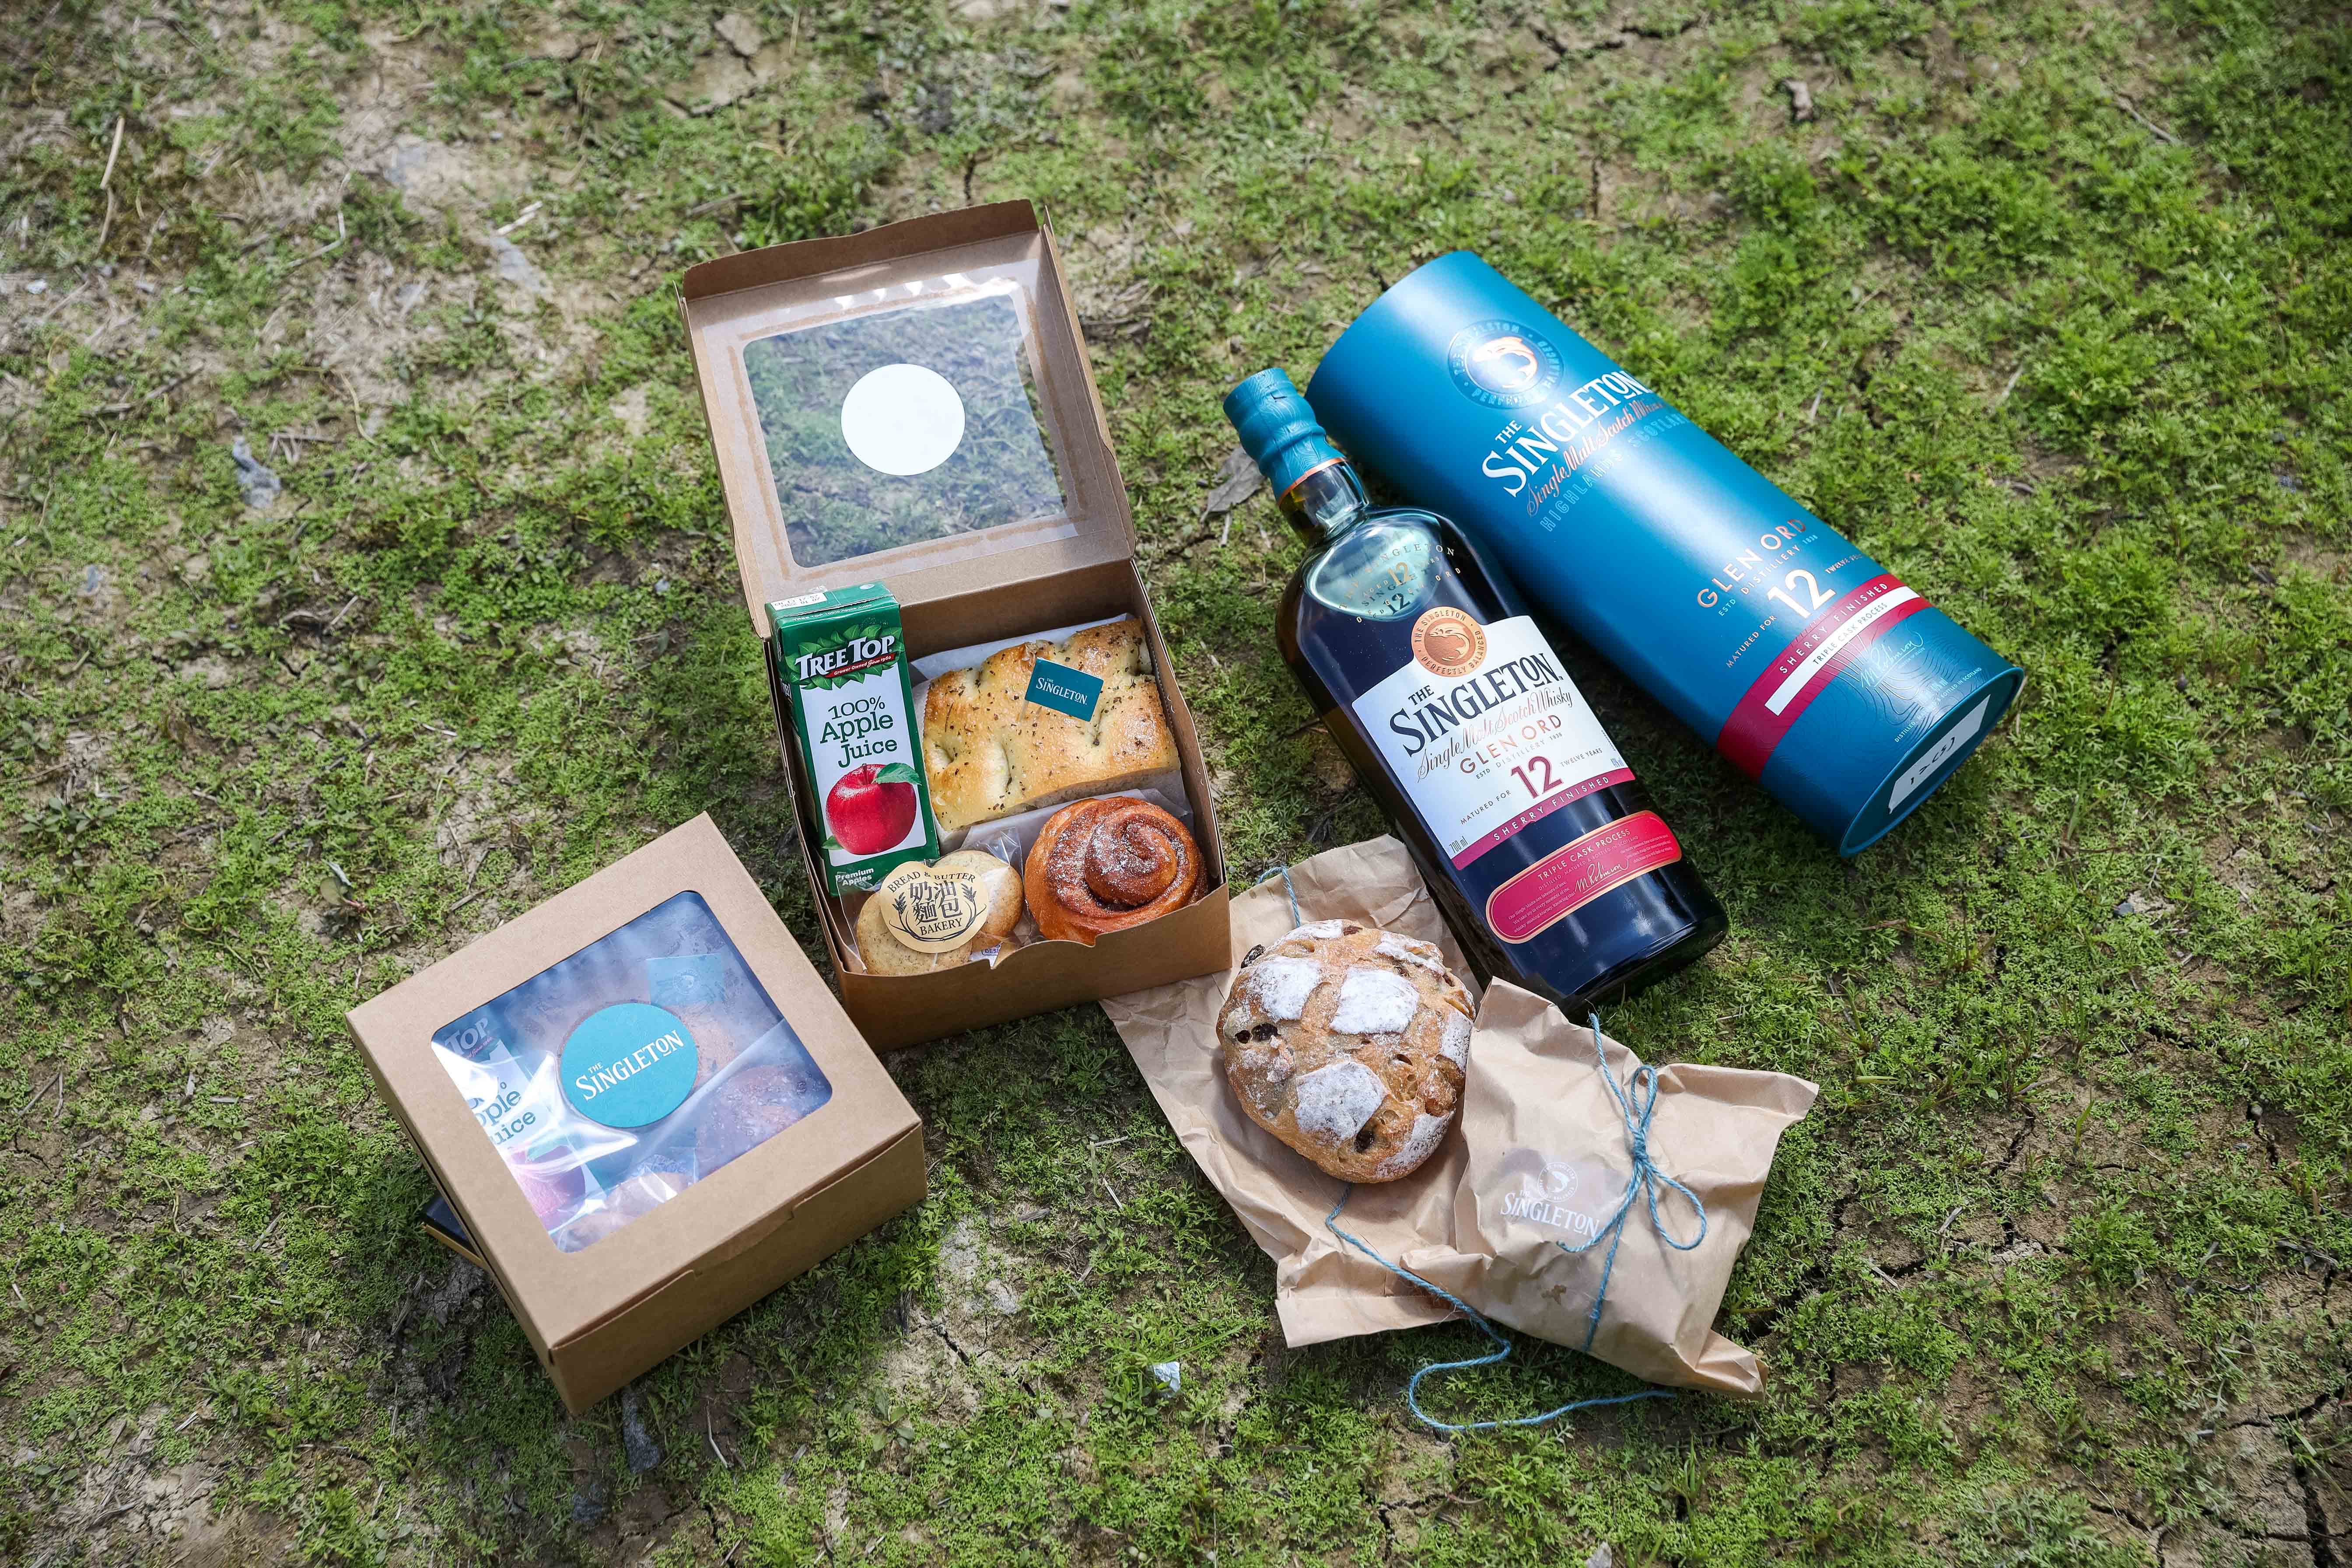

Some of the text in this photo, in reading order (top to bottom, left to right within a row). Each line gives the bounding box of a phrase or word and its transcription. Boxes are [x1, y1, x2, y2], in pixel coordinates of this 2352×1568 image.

[1482, 370, 1654, 497] SINGLETON
[1495, 420, 1522, 444] THE
[1627, 413, 1691, 448] SCOTLAN
[1526, 464, 1566, 518] Single
[1563, 435, 1598, 478] Malt
[1596, 406, 1635, 447] Scotch
[1387, 562, 1411, 586] 12
[1435, 567, 1461, 581] ORD
[1697, 518, 1807, 608] GLEN ORD
[1718, 598, 1736, 616] ESTD
[1740, 544, 1801, 595] DISTILLERY
[1767, 568, 1837, 620] 12
[1414, 610, 1466, 643] THE SINGLETON
[1726, 615, 1778, 668] MATURED FOR
[1779, 583, 1888, 674] SHERRY FINISHED
[1813, 602, 1888, 665] TRIPLE CASK PROCESS
[794, 635, 895, 681] TREE TOP
[833, 667, 850, 676] Grower
[851, 662, 867, 670] Owned
[867, 659, 880, 668] Since
[1421, 630, 1485, 675] PERFECTLY BALANCED
[828, 696, 886, 720] 100%
[1036, 677, 1087, 705] SINGLETON
[1390, 653, 1560, 758] SINGLETON
[1407, 685, 1435, 706] THE
[820, 711, 893, 744] Apple
[1418, 686, 1574, 784] Single Malt Scotch Whisky
[1460, 714, 1561, 774] GLEN ORD
[838, 739, 898, 768] Juice
[1476, 732, 1563, 780] ESTD DISTILLERY 1838
[1560, 748, 1603, 767] TWELVE YEARS
[1510, 756, 1564, 799] 12
[1460, 790, 1512, 825] MATURED FOR
[1493, 776, 1610, 841] SHERRY FINISHED
[1449, 835, 1468, 854] 700 ml
[1537, 860, 1568, 881] TRIPLE
[1570, 845, 1594, 862] CASK
[1596, 829, 1631, 849] PROCESS
[836, 868, 874, 880] Premium
[842, 874, 872, 886] Apples
[887, 871, 921, 893] BREAD
[934, 872, 976, 883] BUTTER
[1564, 861, 1586, 875] MATURED
[909, 880, 958, 905] 奶油
[913, 896, 963, 926] 麵包
[920, 917, 963, 936] BAKERY
[444, 1018, 488, 1054] TOP
[575, 1029, 684, 1102] SINGLETON
[588, 1062, 603, 1073] THE
[474, 1091, 522, 1127] pple
[490, 1112, 536, 1145] uice
[1499, 1192, 1600, 1239] SINGLETON
